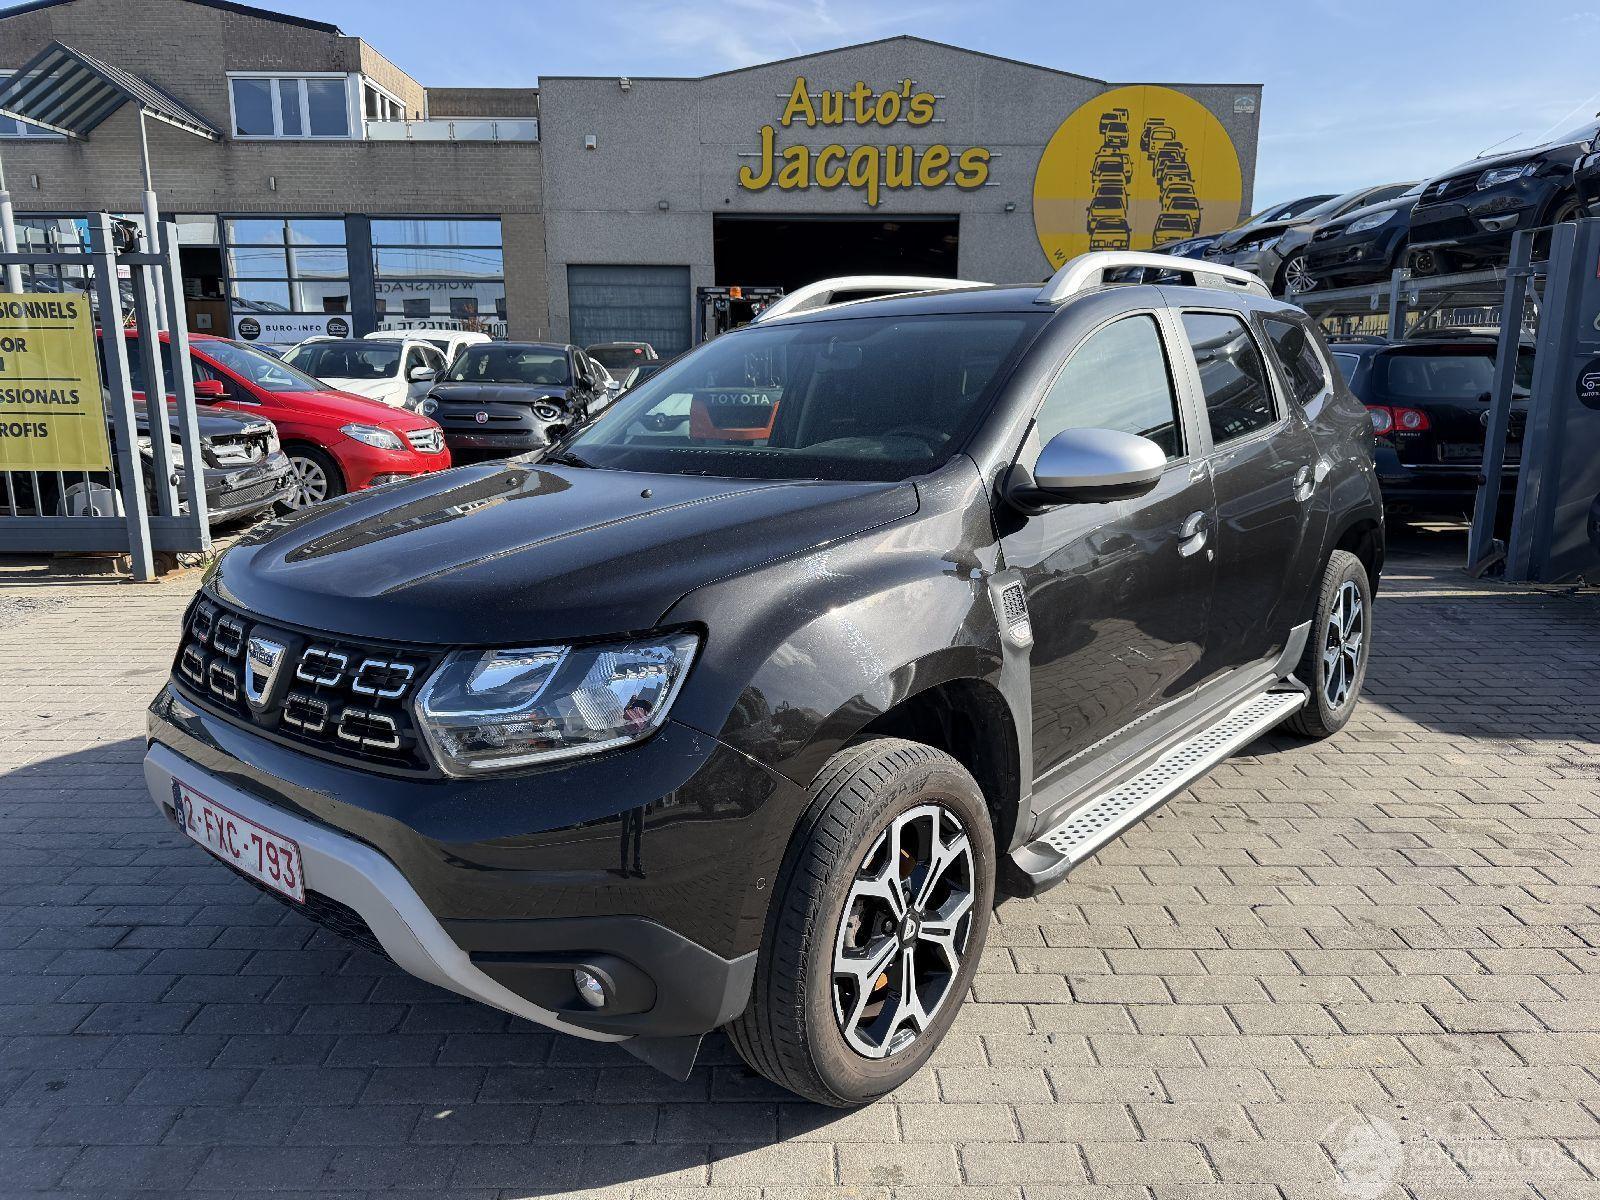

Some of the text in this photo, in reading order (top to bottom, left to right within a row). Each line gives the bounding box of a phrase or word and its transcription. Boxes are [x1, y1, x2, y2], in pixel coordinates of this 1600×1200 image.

[781, 76, 936, 127] Auto's
[739, 125, 991, 207] Jacques
[710, 394, 770, 405] TOYOTA
[184, 795, 296, 888] 2-FXC-793
